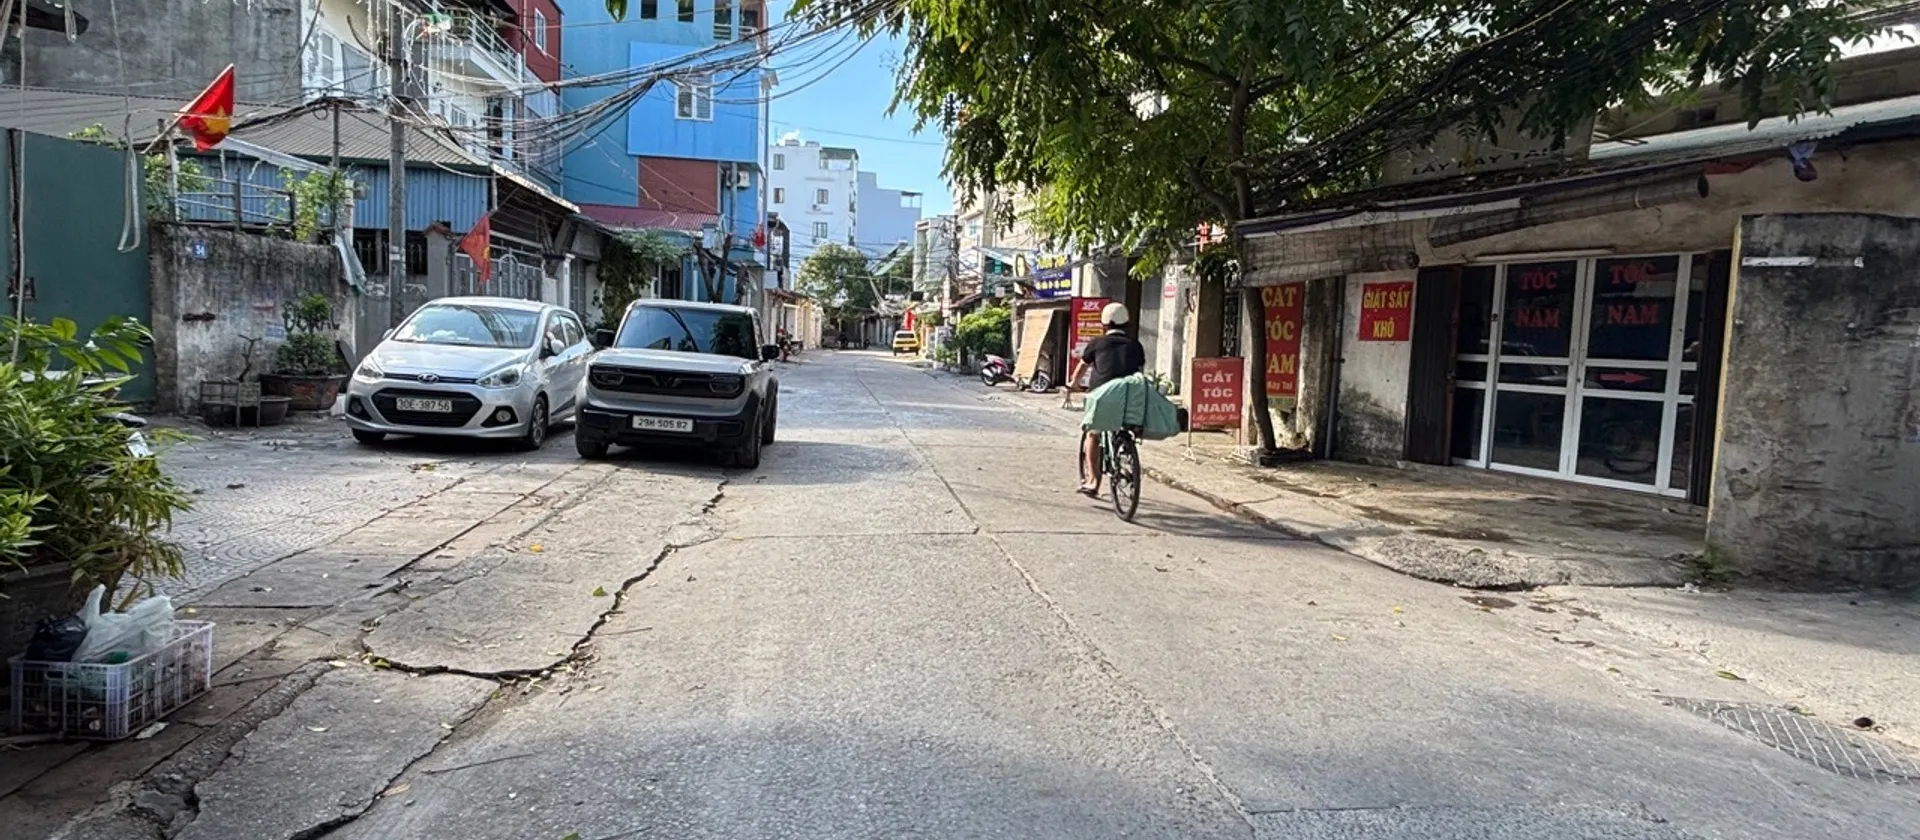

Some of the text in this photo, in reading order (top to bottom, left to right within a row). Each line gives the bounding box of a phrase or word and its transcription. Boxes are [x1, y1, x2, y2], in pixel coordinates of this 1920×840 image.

[1521, 267, 1557, 290] TÓC
[1515, 307, 1559, 327] NAM
[1606, 304, 1658, 324] NAM
[1266, 353, 1295, 374] AM
[1202, 387, 1233, 398] TÓC
[1197, 403, 1236, 413] NAM
